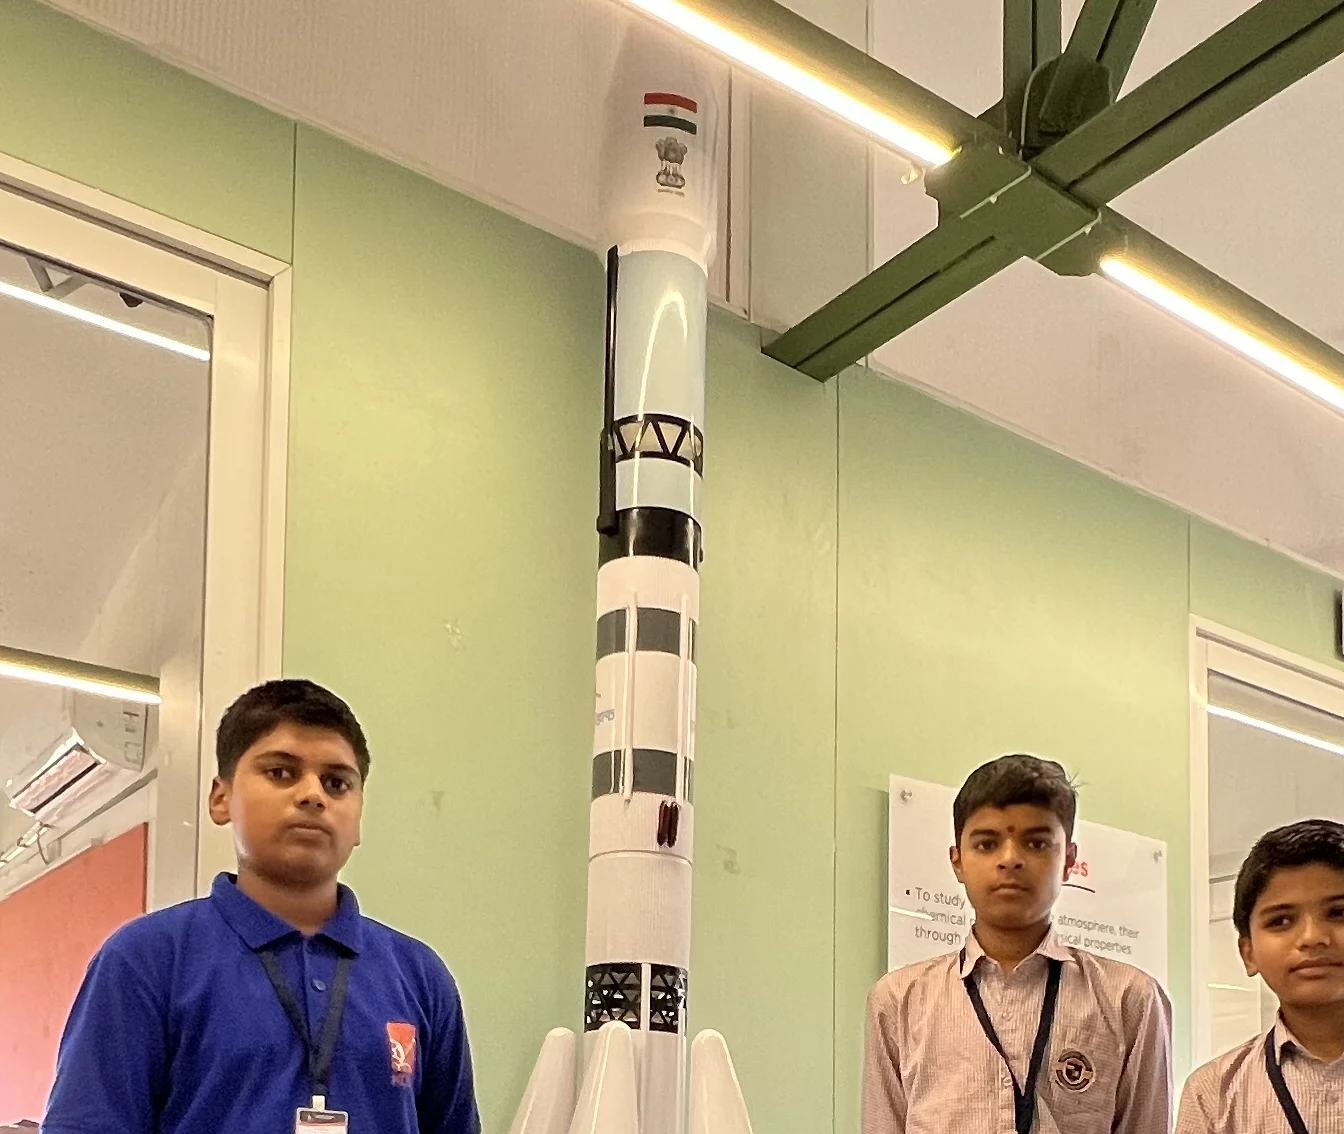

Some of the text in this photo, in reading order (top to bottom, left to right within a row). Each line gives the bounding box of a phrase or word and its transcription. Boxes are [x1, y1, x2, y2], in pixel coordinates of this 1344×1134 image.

[915, 886, 966, 910] To study
[915, 926, 961, 945] through
